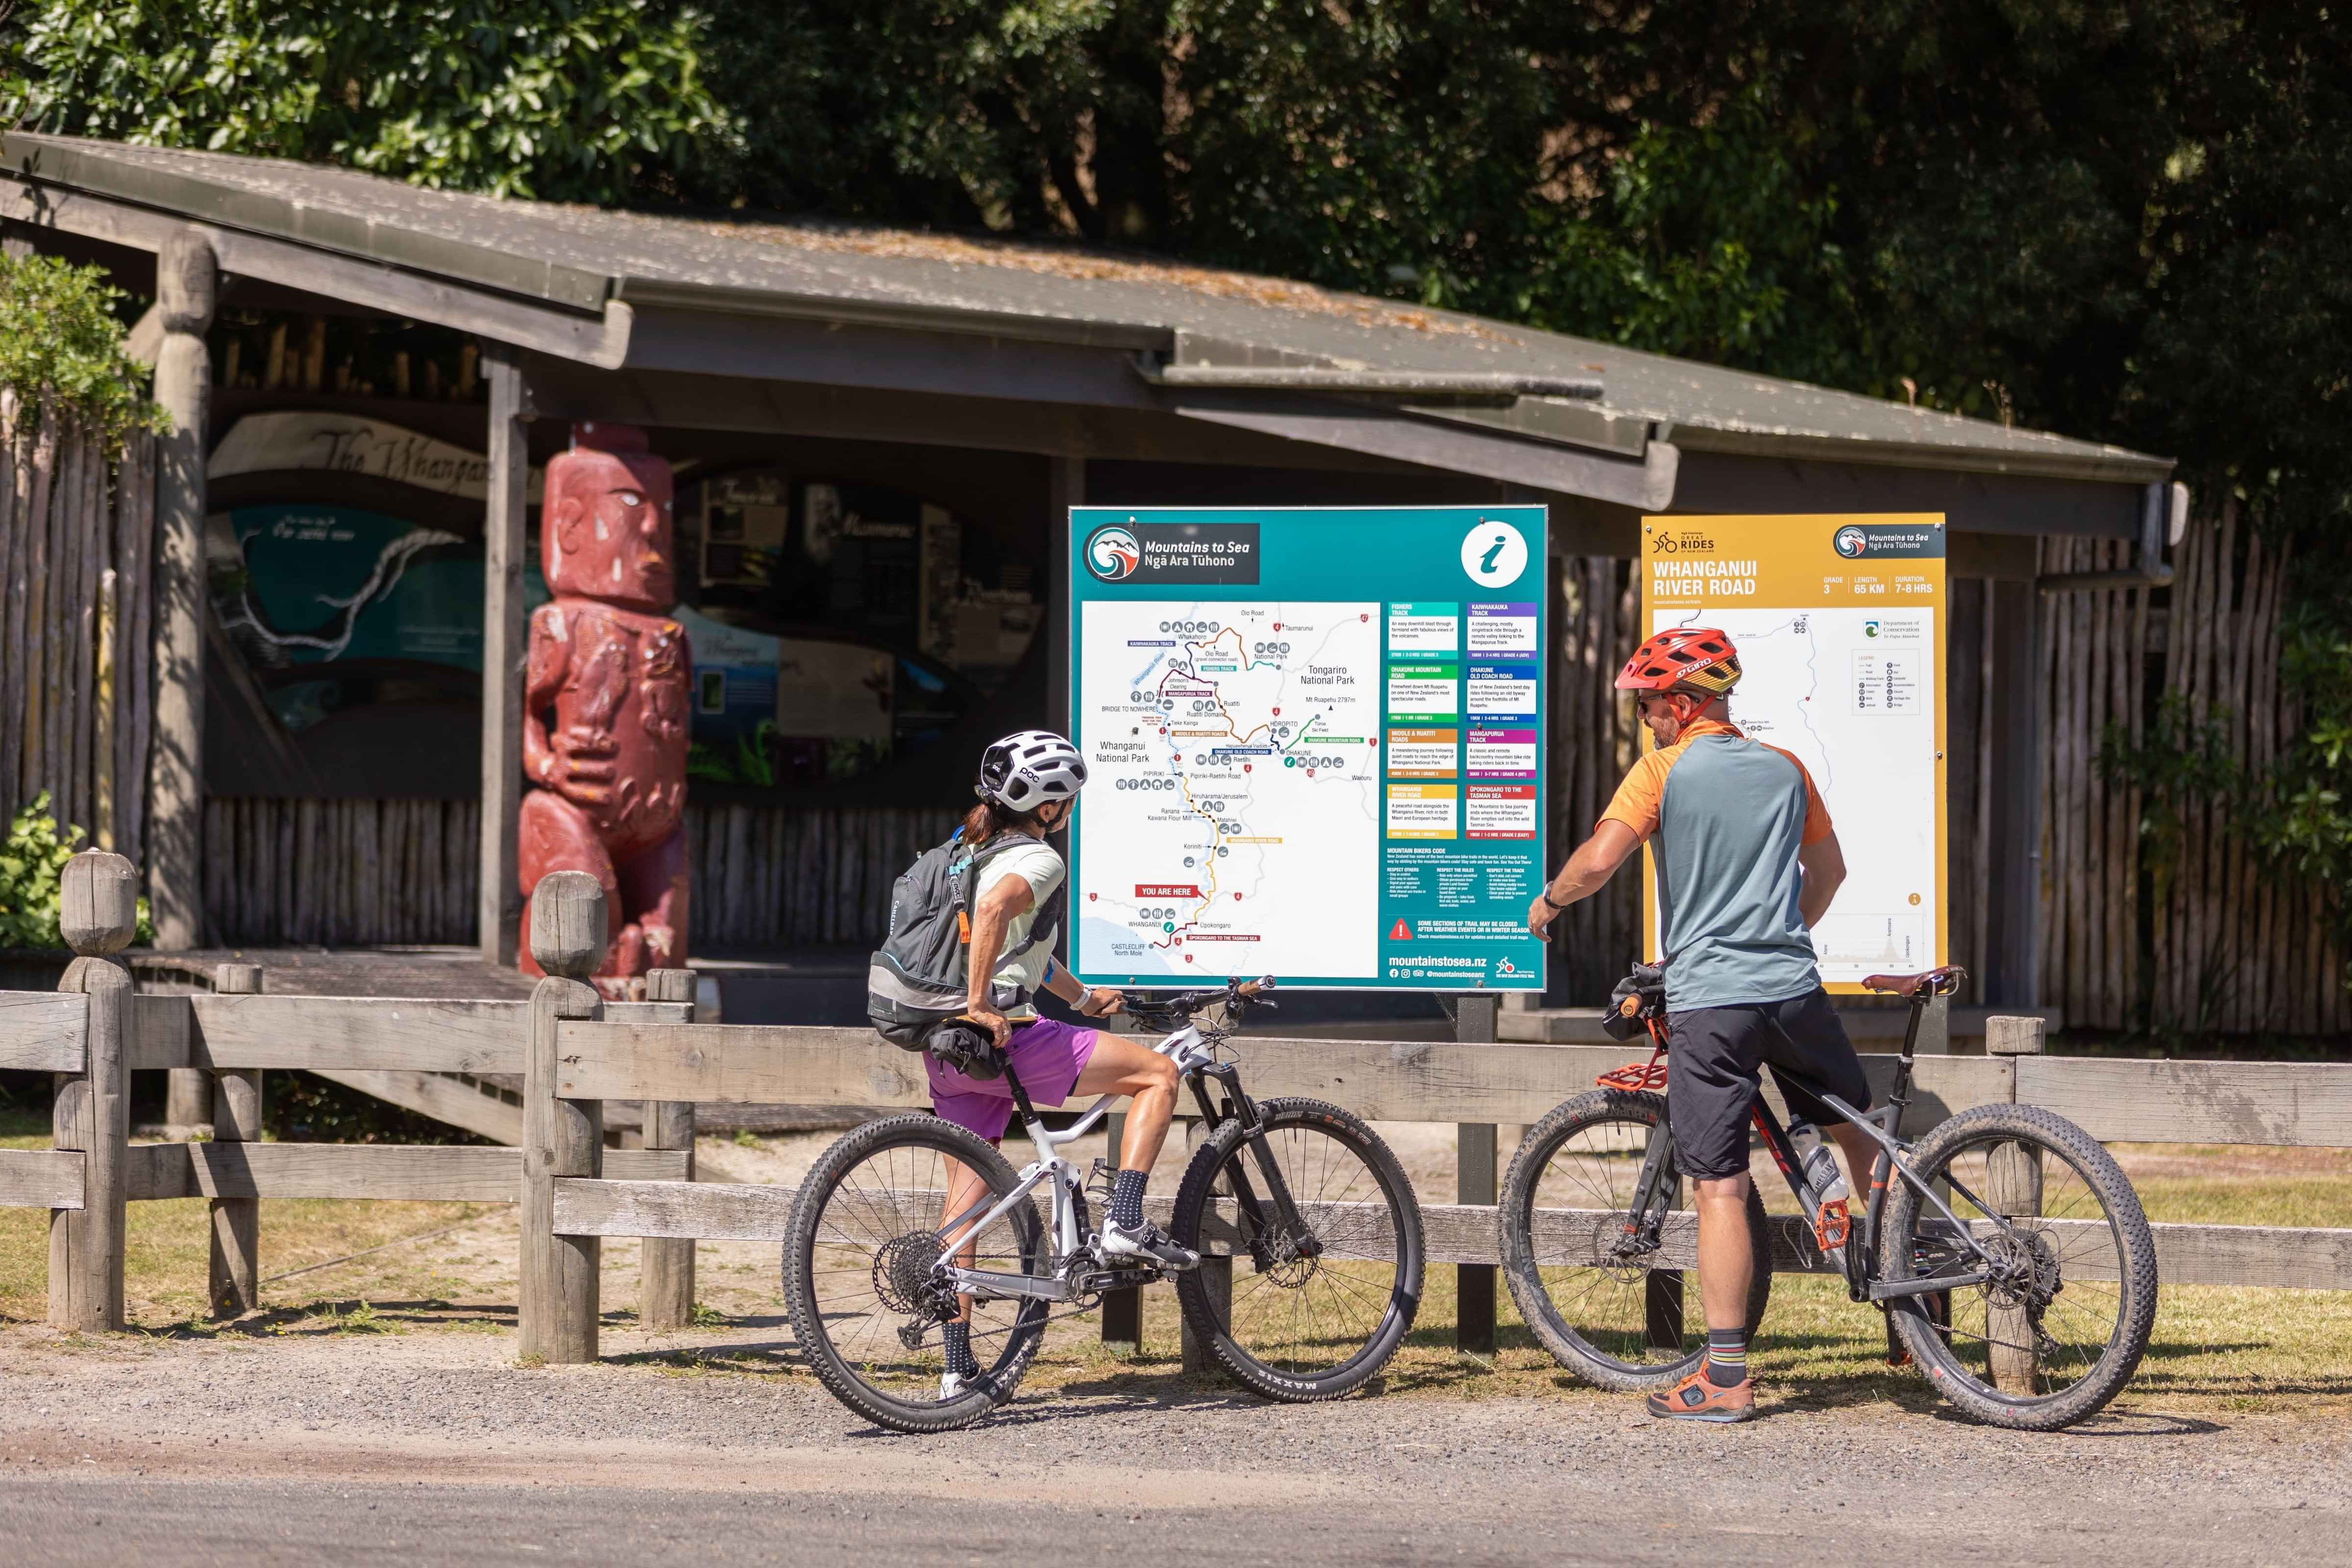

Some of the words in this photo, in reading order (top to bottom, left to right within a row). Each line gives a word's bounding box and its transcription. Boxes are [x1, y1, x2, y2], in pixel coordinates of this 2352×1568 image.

[313, 427, 374, 471] The
[1146, 541, 1209, 553] Mountains
[1212, 543, 1224, 553] to
[1227, 542, 1250, 553] Sea
[1681, 540, 1714, 549] RIDES
[1146, 555, 1167, 568] Ngā
[1170, 556, 1189, 566] Ara
[1193, 555, 1234, 566] Tūhono
[1653, 561, 1757, 577] WHANGANUI
[1654, 580, 1703, 595] RIVER
[1710, 579, 1755, 595] ROAD
[1824, 585, 1830, 593] 3
[1854, 585, 1866, 593] 65
[1869, 585, 1884, 593] KM
[1895, 584, 1911, 593] 7-8
[1914, 584, 1933, 593] HRS
[1133, 662, 1155, 685] Whanganui
[1154, 653, 1164, 664] River
[1309, 666, 1347, 676] Tongariro
[1687, 658, 1712, 673] GIRO
[1101, 741, 1145, 752] Whanganui
[1389, 956, 1487, 967] mountainstosea.nz
[1258, 1370, 1317, 1390] MAXXIS
